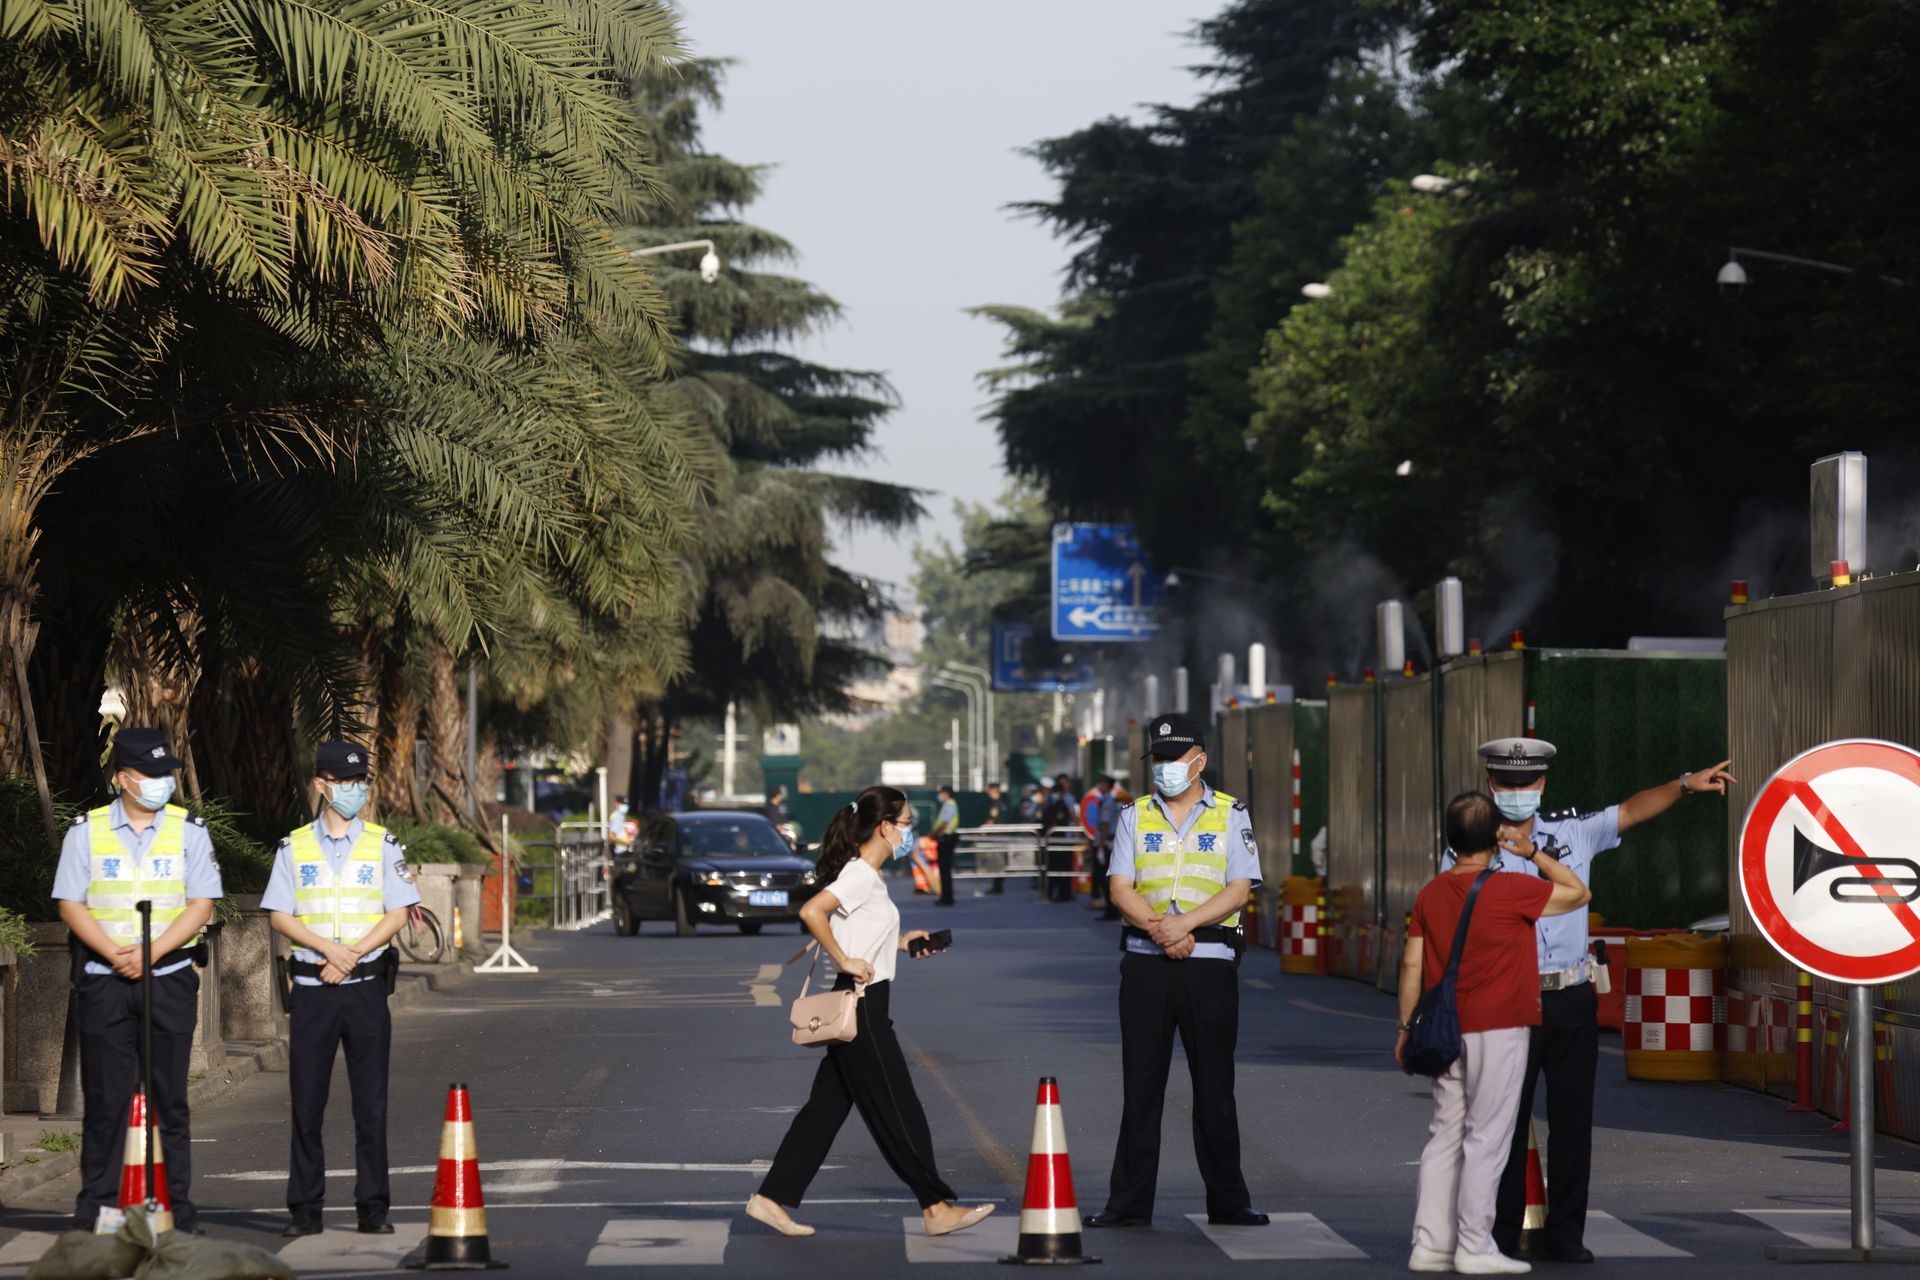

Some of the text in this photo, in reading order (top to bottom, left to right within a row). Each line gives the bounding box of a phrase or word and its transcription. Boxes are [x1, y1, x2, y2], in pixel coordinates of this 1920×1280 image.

[1143, 832, 1217, 853] 警 察
[102, 858, 172, 878] 警 察
[299, 864, 320, 887] 警
